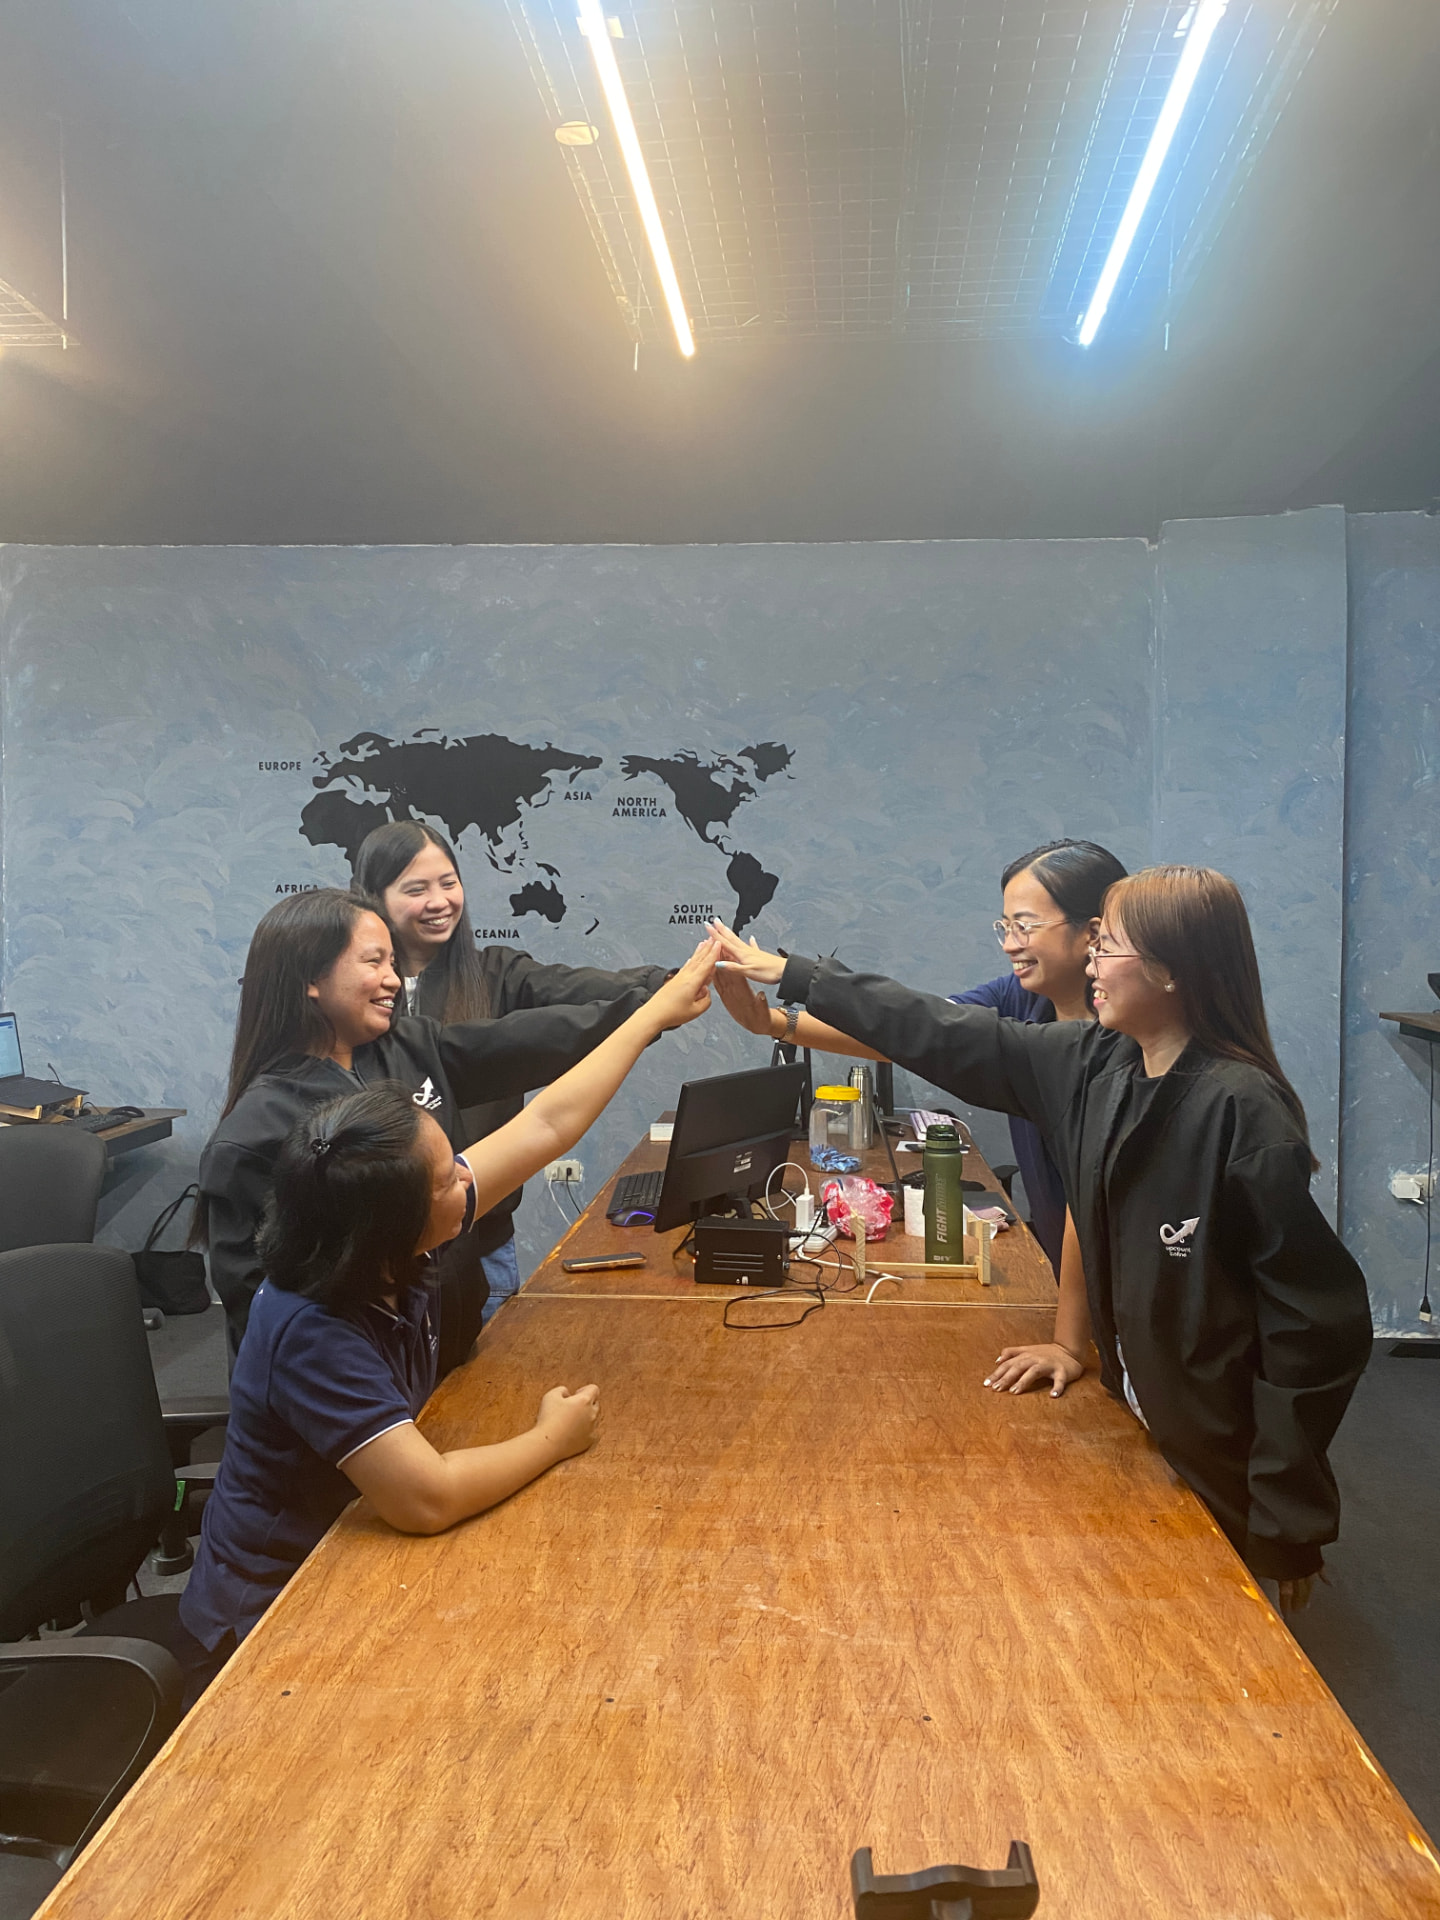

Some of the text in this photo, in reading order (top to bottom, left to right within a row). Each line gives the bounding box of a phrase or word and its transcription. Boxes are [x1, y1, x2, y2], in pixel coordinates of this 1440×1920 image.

[258, 761, 302, 771] EUROPE
[563, 791, 593, 801] ASIA
[617, 796, 657, 807] NORTH
[611, 807, 667, 818] AMERICA
[673, 904, 713, 914] SOUTH
[474, 929, 520, 939] CEANIA
